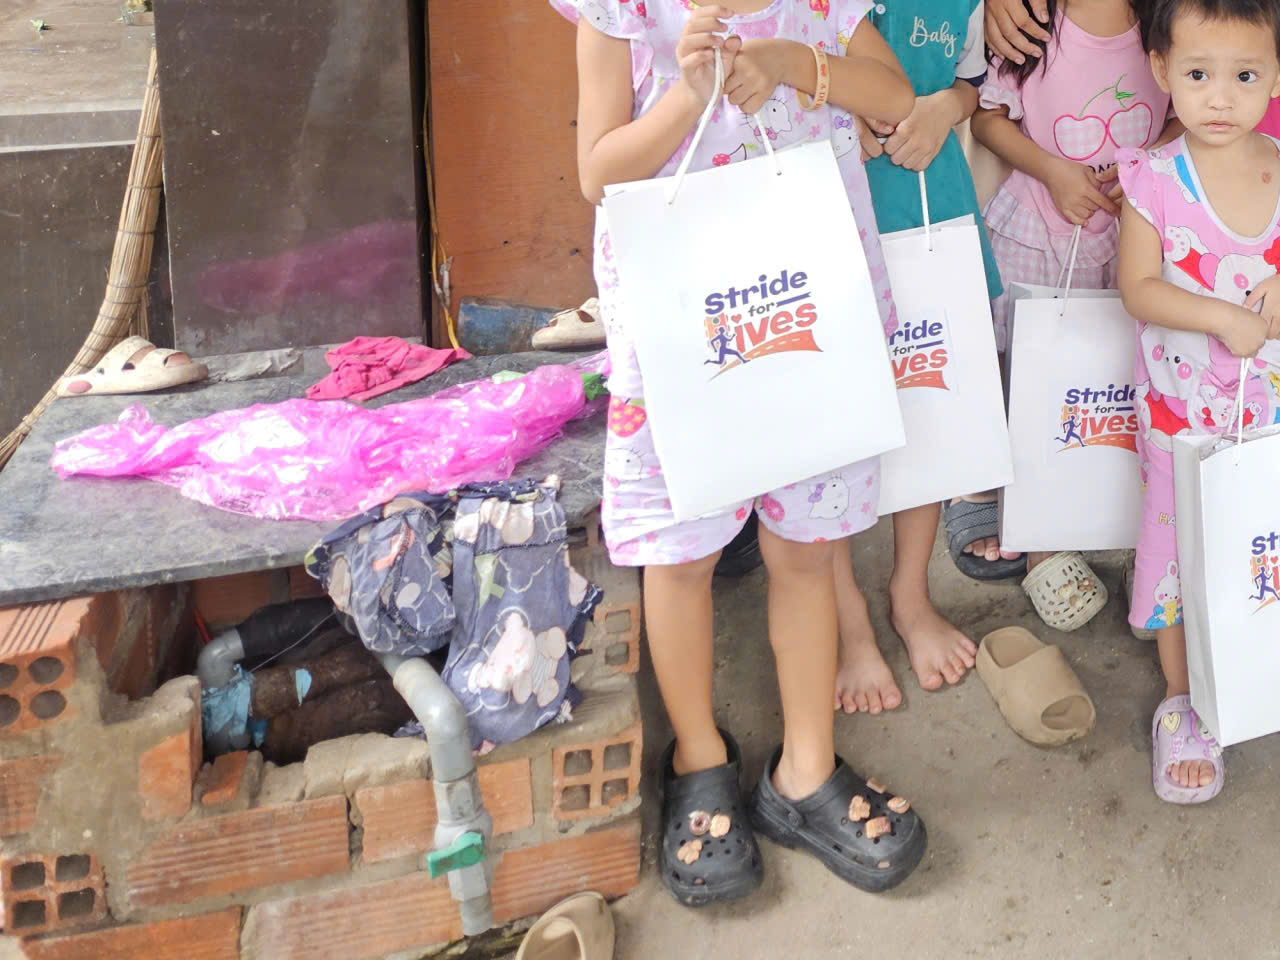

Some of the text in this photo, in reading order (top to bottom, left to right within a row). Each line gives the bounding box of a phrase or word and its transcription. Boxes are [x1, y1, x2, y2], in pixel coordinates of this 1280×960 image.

[909, 16, 957, 59] Baby
[704, 269, 809, 315] Stride
[747, 302, 775, 317] for
[892, 345, 915, 356] for
[1094, 405, 1115, 414] for
